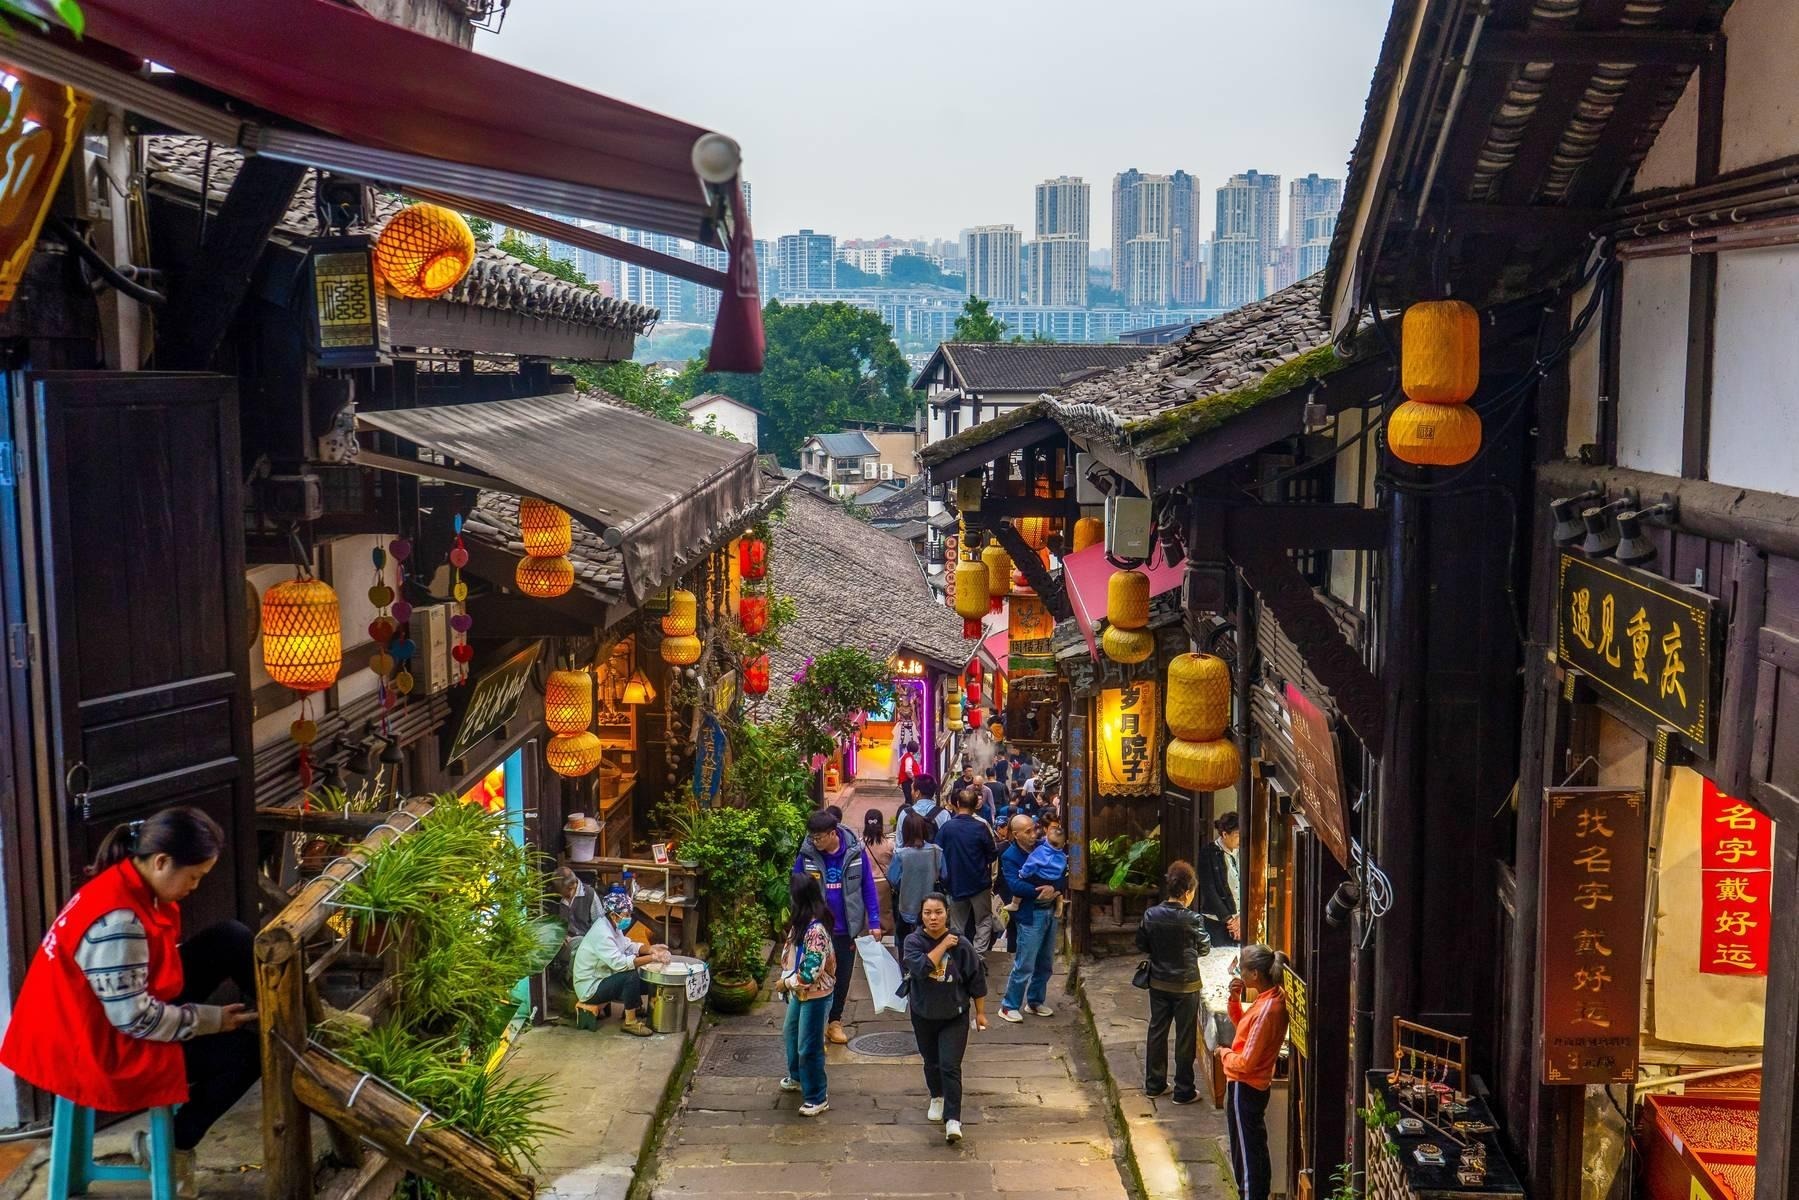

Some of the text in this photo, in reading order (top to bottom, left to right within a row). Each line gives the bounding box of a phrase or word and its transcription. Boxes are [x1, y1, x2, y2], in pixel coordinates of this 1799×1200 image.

[1712, 794, 1758, 969] 名字戴好运
